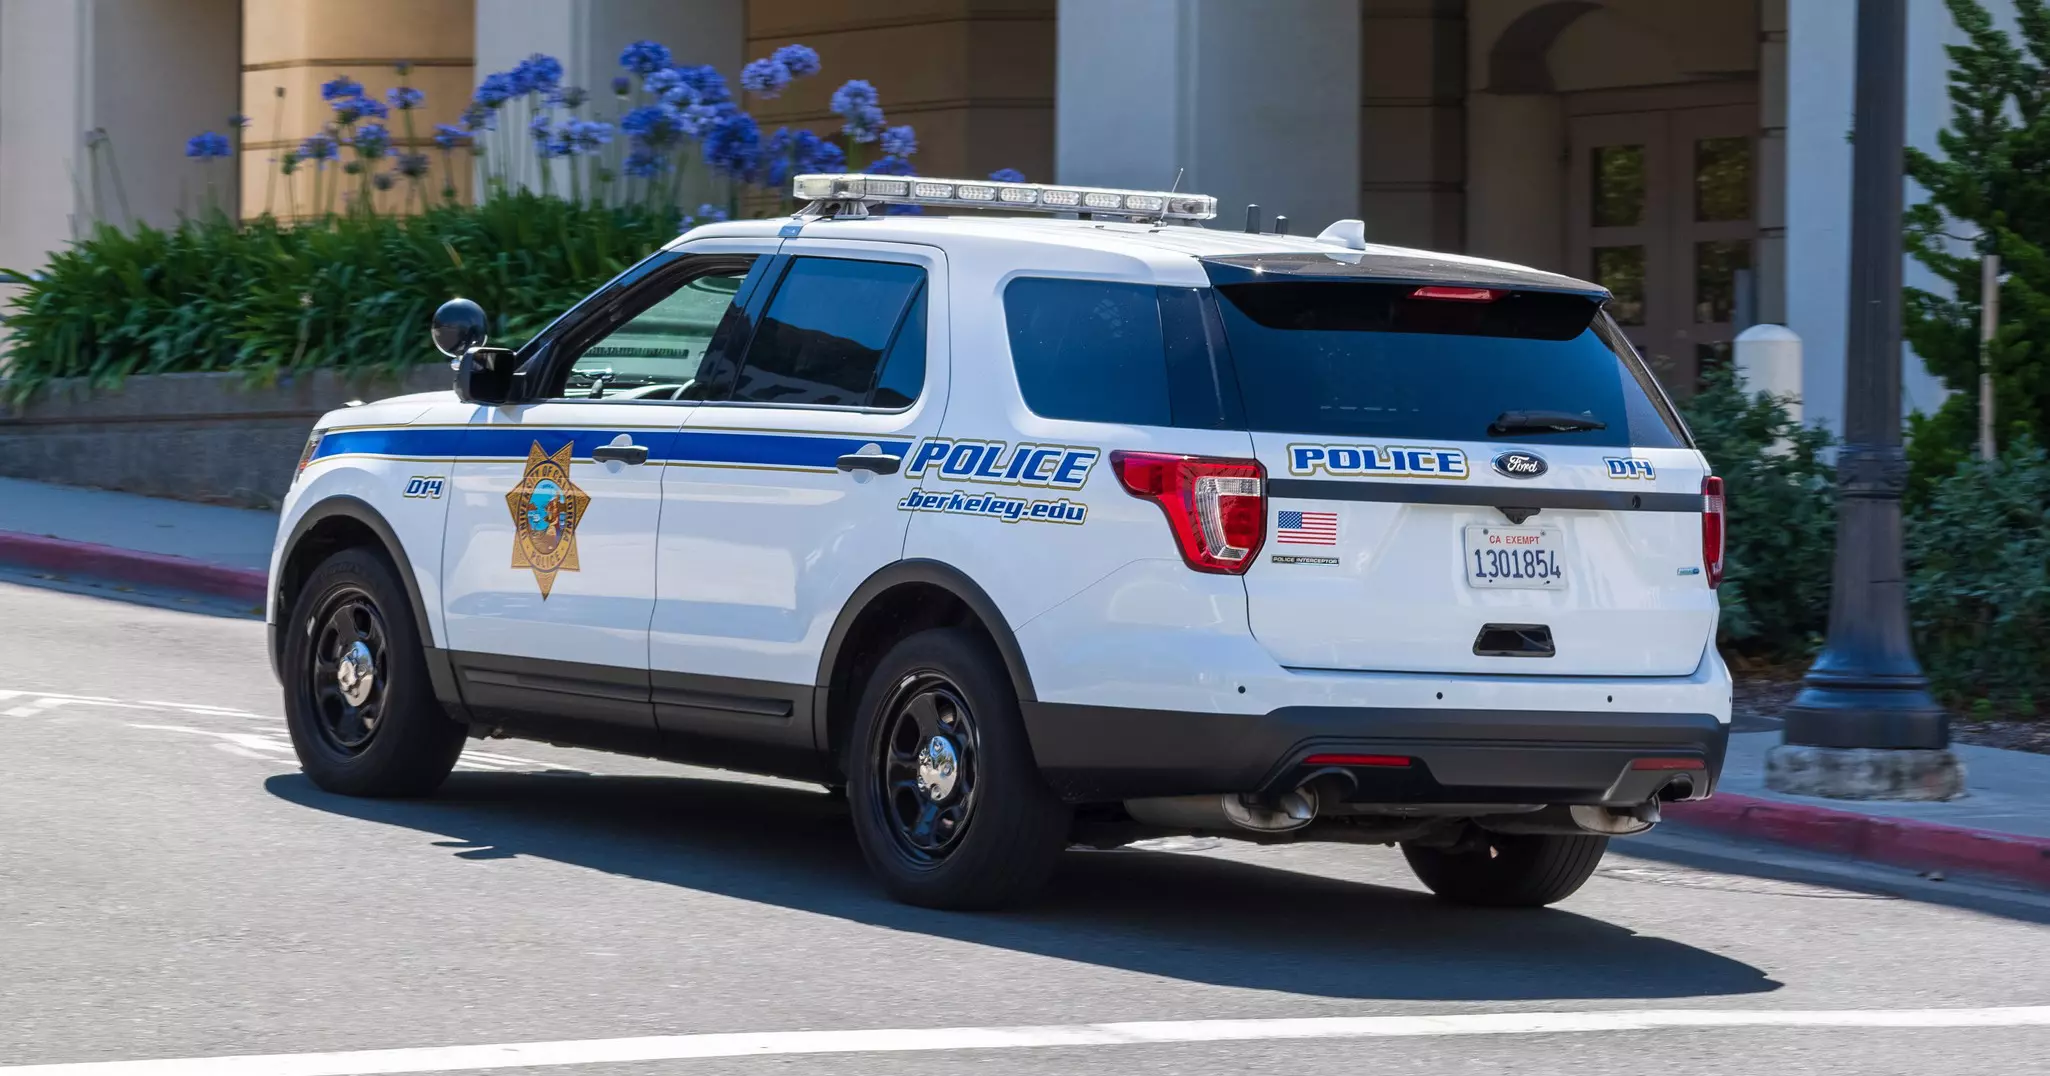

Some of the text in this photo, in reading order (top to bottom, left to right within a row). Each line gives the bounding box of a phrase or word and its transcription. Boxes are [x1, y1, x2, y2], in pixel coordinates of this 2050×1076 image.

[908, 440, 1098, 486] POLICE
[1292, 447, 1465, 475] POLICE
[1507, 455, 1538, 473] Ford
[1606, 459, 1654, 476] D14
[405, 478, 444, 497] D14
[899, 488, 1087, 522] .berkeley.edu
[1489, 535, 1540, 545] CA EXEMPT
[530, 551, 560, 569] POLICE
[1474, 548, 1562, 579] 1301854
